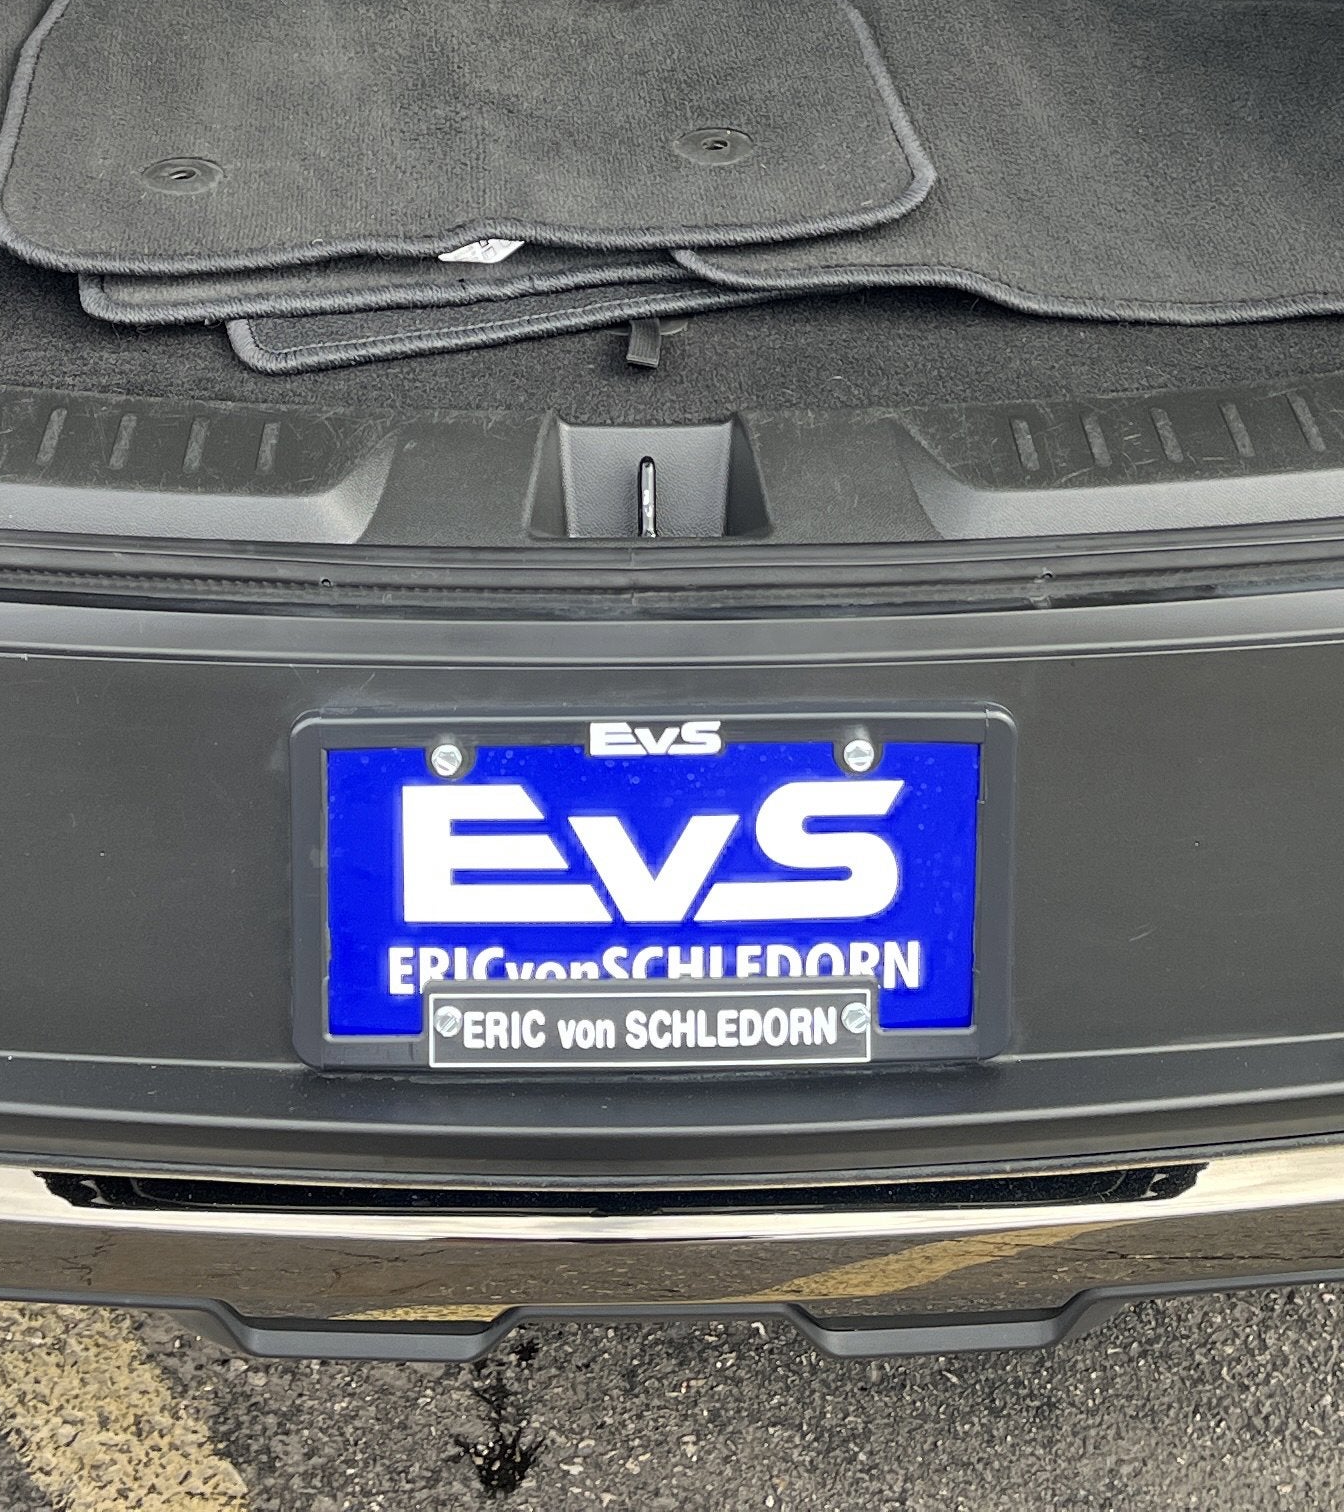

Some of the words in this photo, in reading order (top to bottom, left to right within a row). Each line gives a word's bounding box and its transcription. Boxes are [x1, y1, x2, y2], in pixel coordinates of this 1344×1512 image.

[462, 1009, 546, 1050] ERIC
[557, 1015, 616, 1050] von
[625, 1006, 838, 1050] SCHLEDORN
